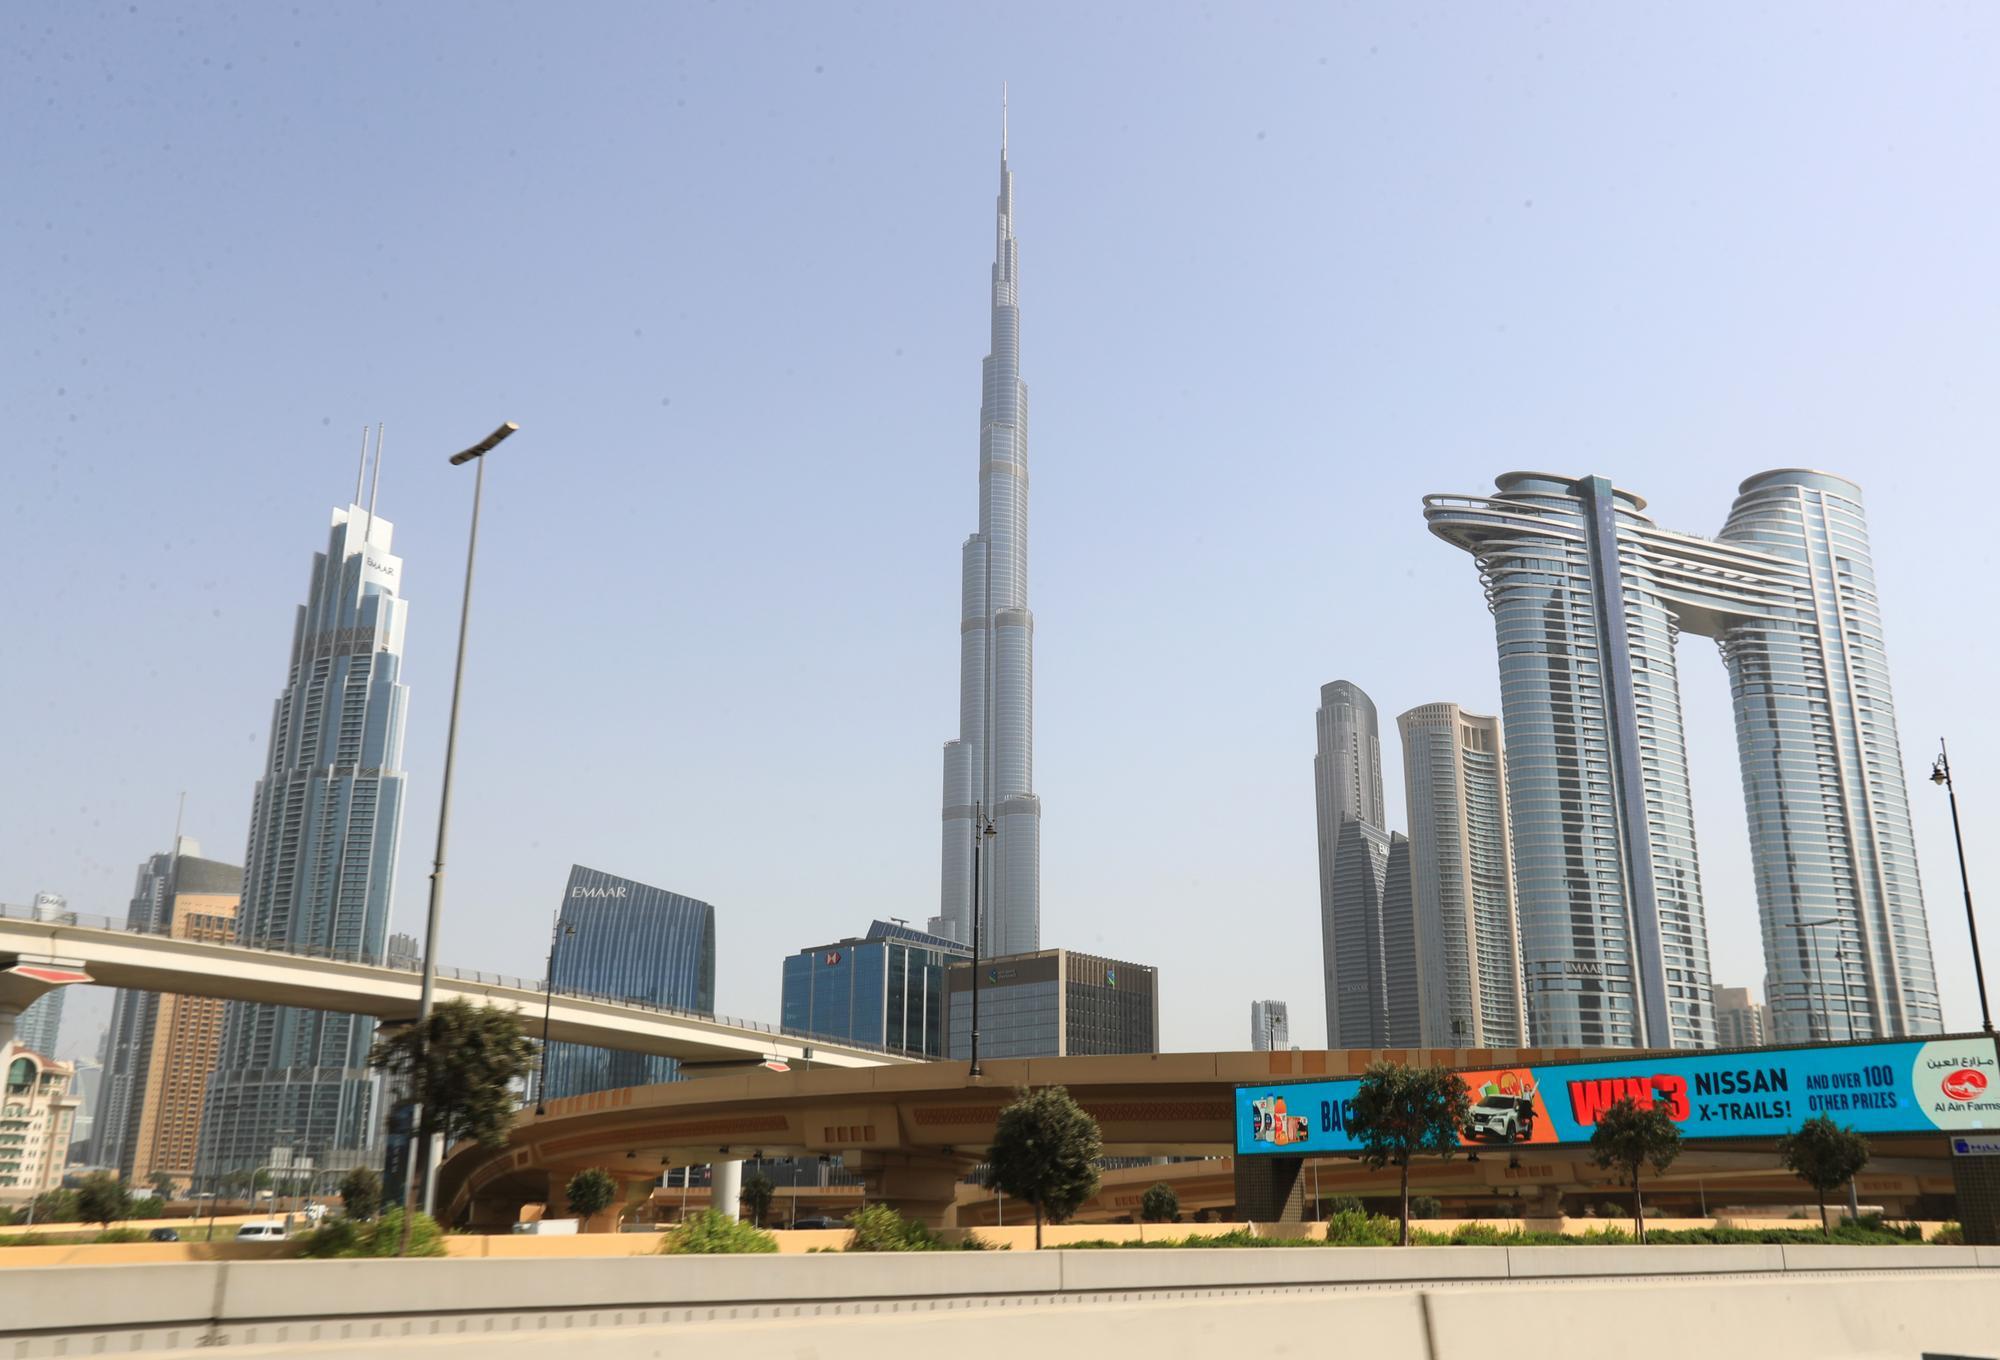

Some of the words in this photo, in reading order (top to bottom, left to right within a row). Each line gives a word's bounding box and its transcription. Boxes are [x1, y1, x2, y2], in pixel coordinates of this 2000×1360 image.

[571, 886, 627, 898] EMAAR
[1926, 1057, 1959, 1069] العين
[1960, 1056, 1994, 1068] مزارع
[1694, 1067, 1789, 1096] NISSAN
[1806, 1074, 1830, 1090] AND
[1831, 1072, 1862, 1089] OVER
[1863, 1065, 1895, 1087] 100
[1651, 1074, 1690, 1122] 3
[1808, 1093, 1849, 1111] OTHER
[1852, 1091, 1898, 1110] PRIZES
[1935, 1102, 1946, 1112] Al
[1948, 1102, 1966, 1111] Ain
[1967, 1101, 2000, 1111] Farms
[1698, 1100, 1792, 1121] X-TRAILS!
